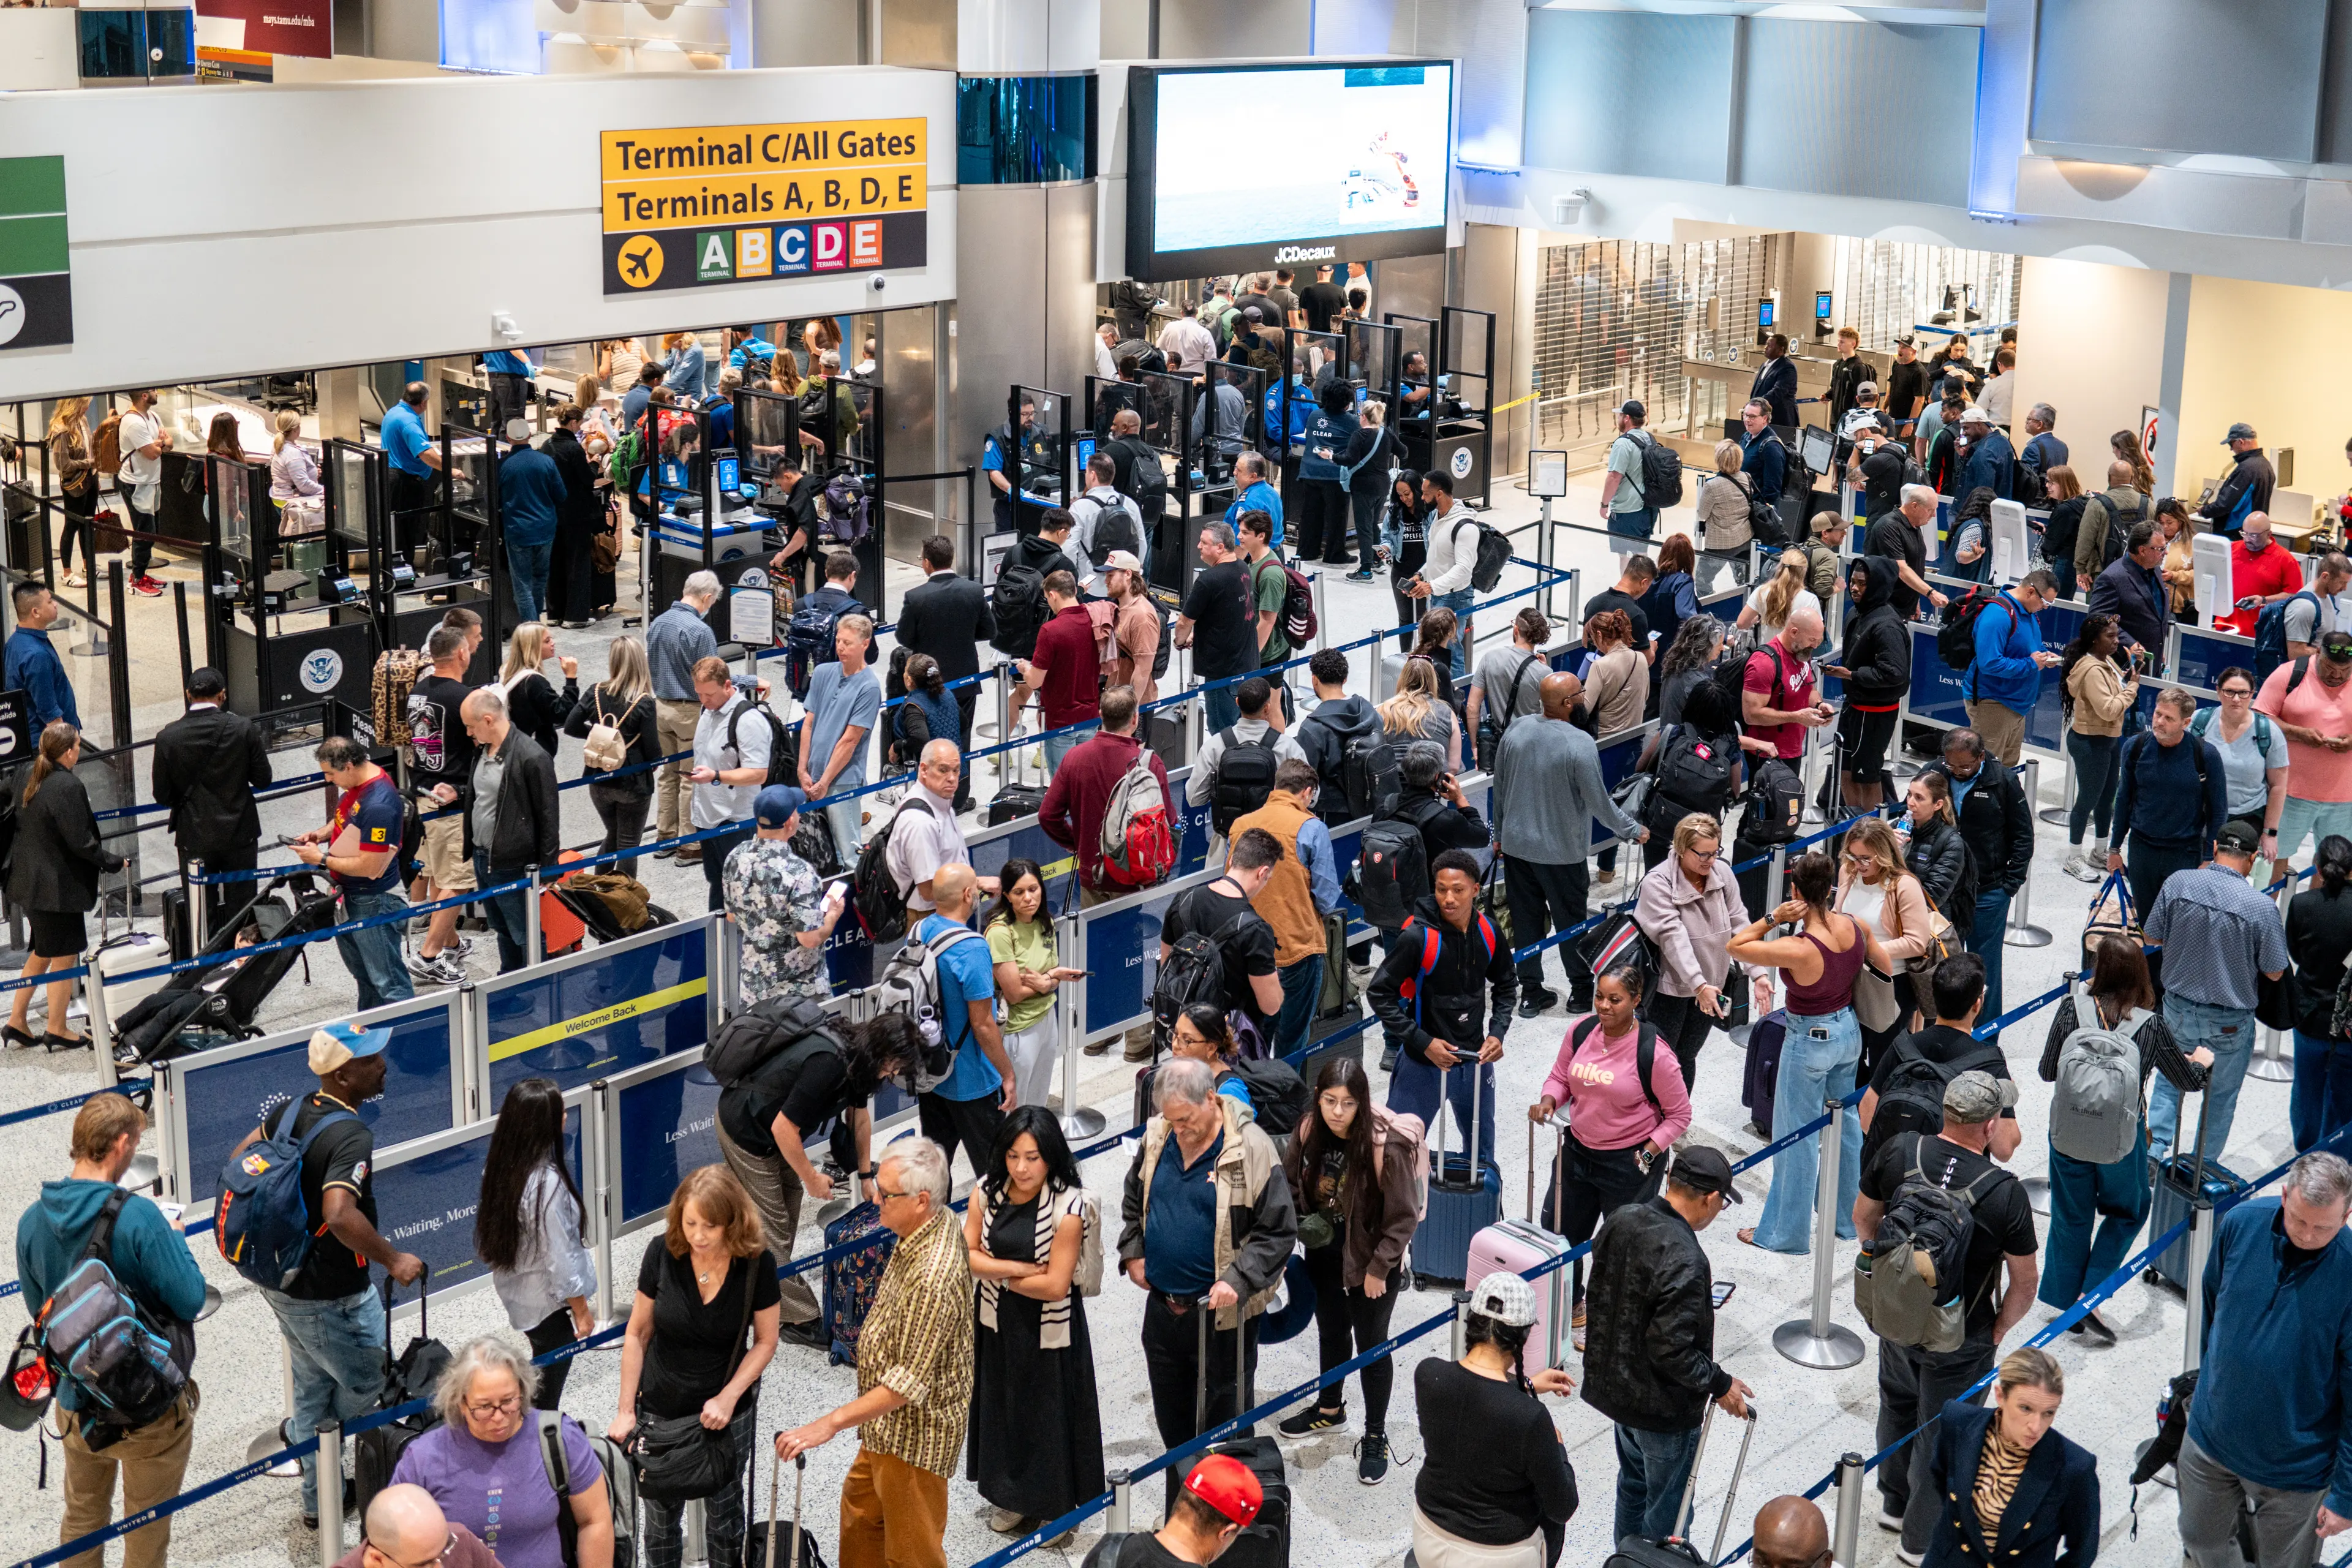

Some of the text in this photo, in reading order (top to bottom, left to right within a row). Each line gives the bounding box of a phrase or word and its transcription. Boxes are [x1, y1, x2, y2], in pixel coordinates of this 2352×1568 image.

[263, 15, 314, 26] mays.tamu.edu/mba
[616, 130, 916, 170] Terminal C/All Gates
[617, 175, 913, 221] Terminals A, B, D, E
[701, 223, 876, 270] A B C D E
[1275, 246, 1335, 263] JCDecaux
[816, 260, 843, 268] TERMINAL
[853, 257, 880, 265] TERMINAL
[1939, 674, 1954, 685] Less
[352, 714, 375, 737] Pleas
[352, 728, 369, 748] Wait
[378, 830, 385, 840] 3
[492, 884, 511, 894] UNITED
[337, 924, 357, 932] UNITED
[825, 926, 865, 951] CLEA
[859, 940, 872, 948] PLU
[255, 943, 276, 952] UNITED
[1125, 948, 1161, 968] Less Wait
[172, 962, 193, 970] UNITED
[566, 1004, 637, 1033] Welcome Back
[1981, 1025, 1994, 1035] UNITED
[1306, 1046, 1321, 1055] UNITED
[587, 1055, 618, 1069] clearme.com
[1571, 1061, 1615, 1085] nike
[61, 1099, 84, 1108] CLEAR
[2071, 1106, 2103, 1117] Methodist
[666, 1115, 715, 1144] Less Waiti
[1095, 1141, 1113, 1152] UNITED
[1940, 1158, 1957, 1189] PUMA
[394, 1216, 443, 1240] Waiting,
[447, 1204, 478, 1223] More
[880, 1231, 896, 1240] UNIT
[434, 1259, 473, 1277] clearme.com
[796, 1260, 817, 1271] UNITED
[1541, 1261, 1559, 1272] UNITED
[0, 1284, 18, 1294] LEAR
[554, 1346, 579, 1360] UNITED
[1373, 1344, 1392, 1358] UNITED
[1294, 1384, 1313, 1398] UNITED
[1210, 1426, 1232, 1441] UNITED
[236, 1465, 264, 1480] UNITED
[1102, 1494, 1114, 1504] UNI
[116, 1515, 147, 1531] UNITED
[1009, 1539, 1035, 1556] UNITED
